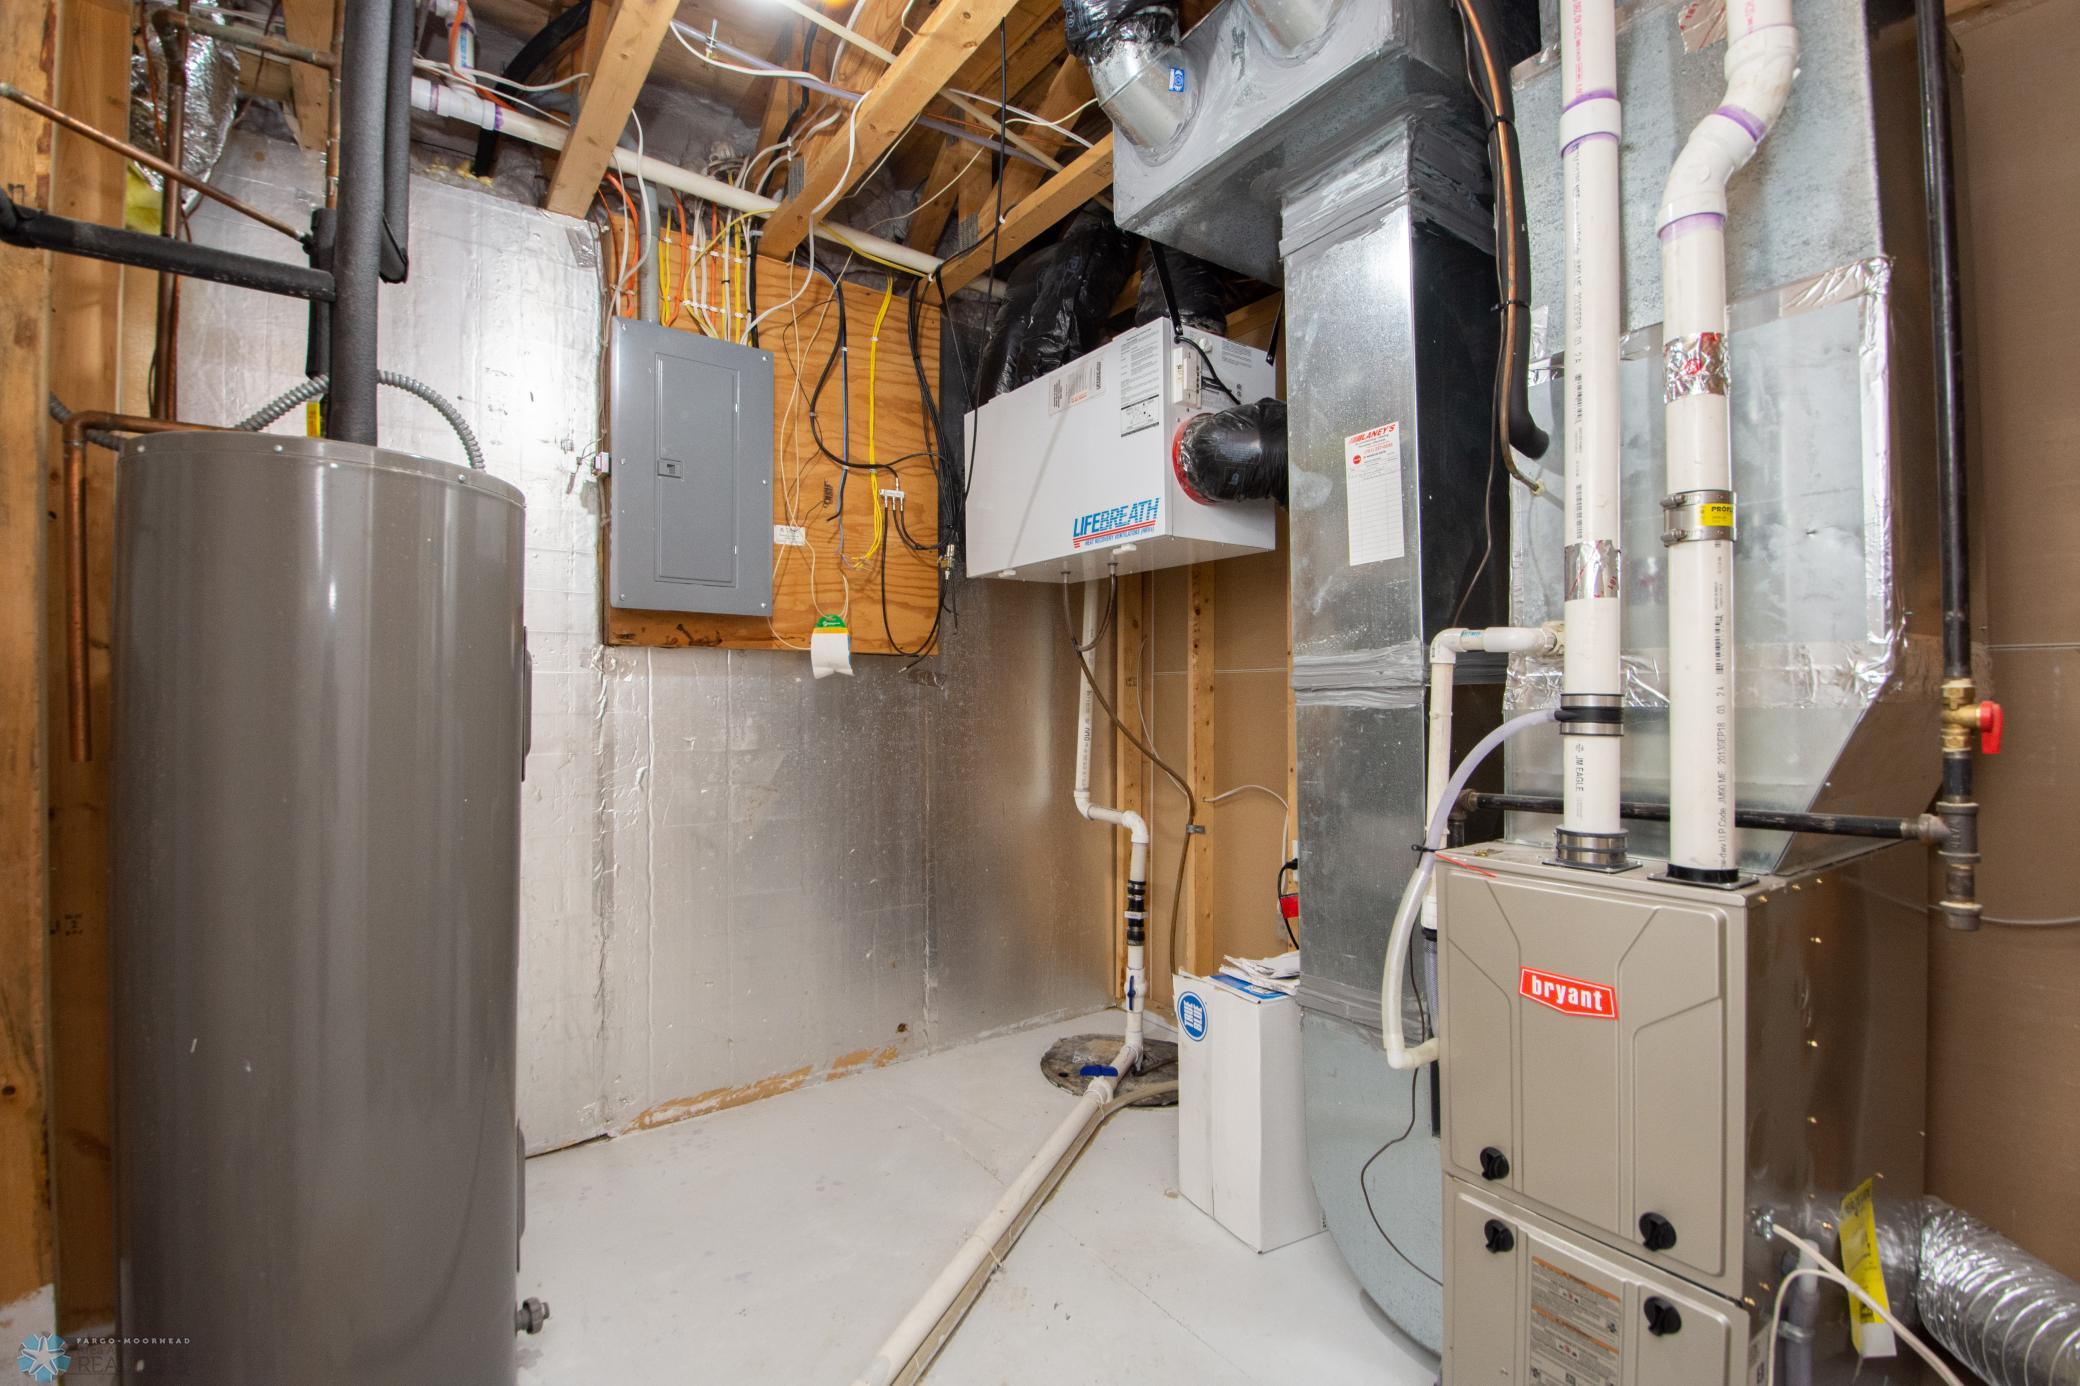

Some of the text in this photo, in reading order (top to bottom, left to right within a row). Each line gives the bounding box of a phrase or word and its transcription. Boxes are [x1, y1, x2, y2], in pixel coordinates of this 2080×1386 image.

[1072, 496, 1160, 537] LIFEBREATH
[1575, 767, 1584, 792] EAGLE
[1531, 975, 1603, 1012] bryant
[1183, 999, 1196, 1028] TRUE
[1192, 1003, 1203, 1033] BLUE
